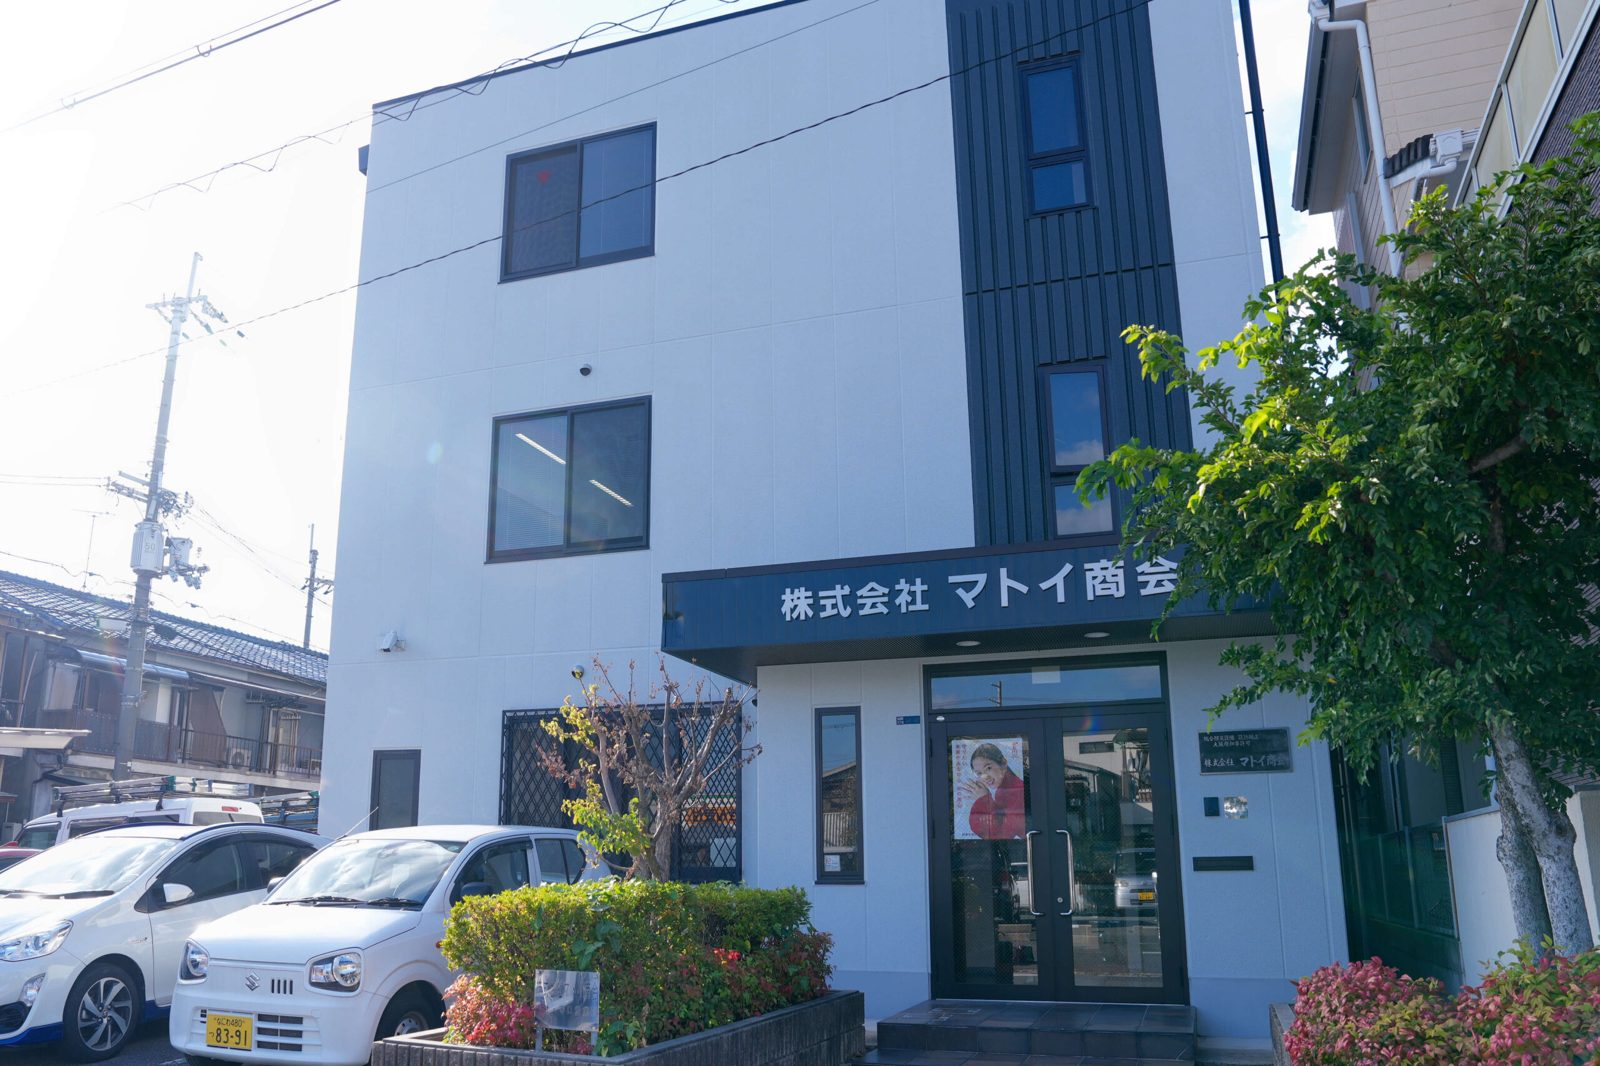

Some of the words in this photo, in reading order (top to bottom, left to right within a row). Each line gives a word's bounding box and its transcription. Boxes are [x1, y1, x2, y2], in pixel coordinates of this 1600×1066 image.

[780, 577, 930, 621] 株式会社
[947, 556, 1179, 608] マトイ商会
[1204, 757, 1236, 768] 株式会社
[215, 1027, 248, 1047] 83-91
